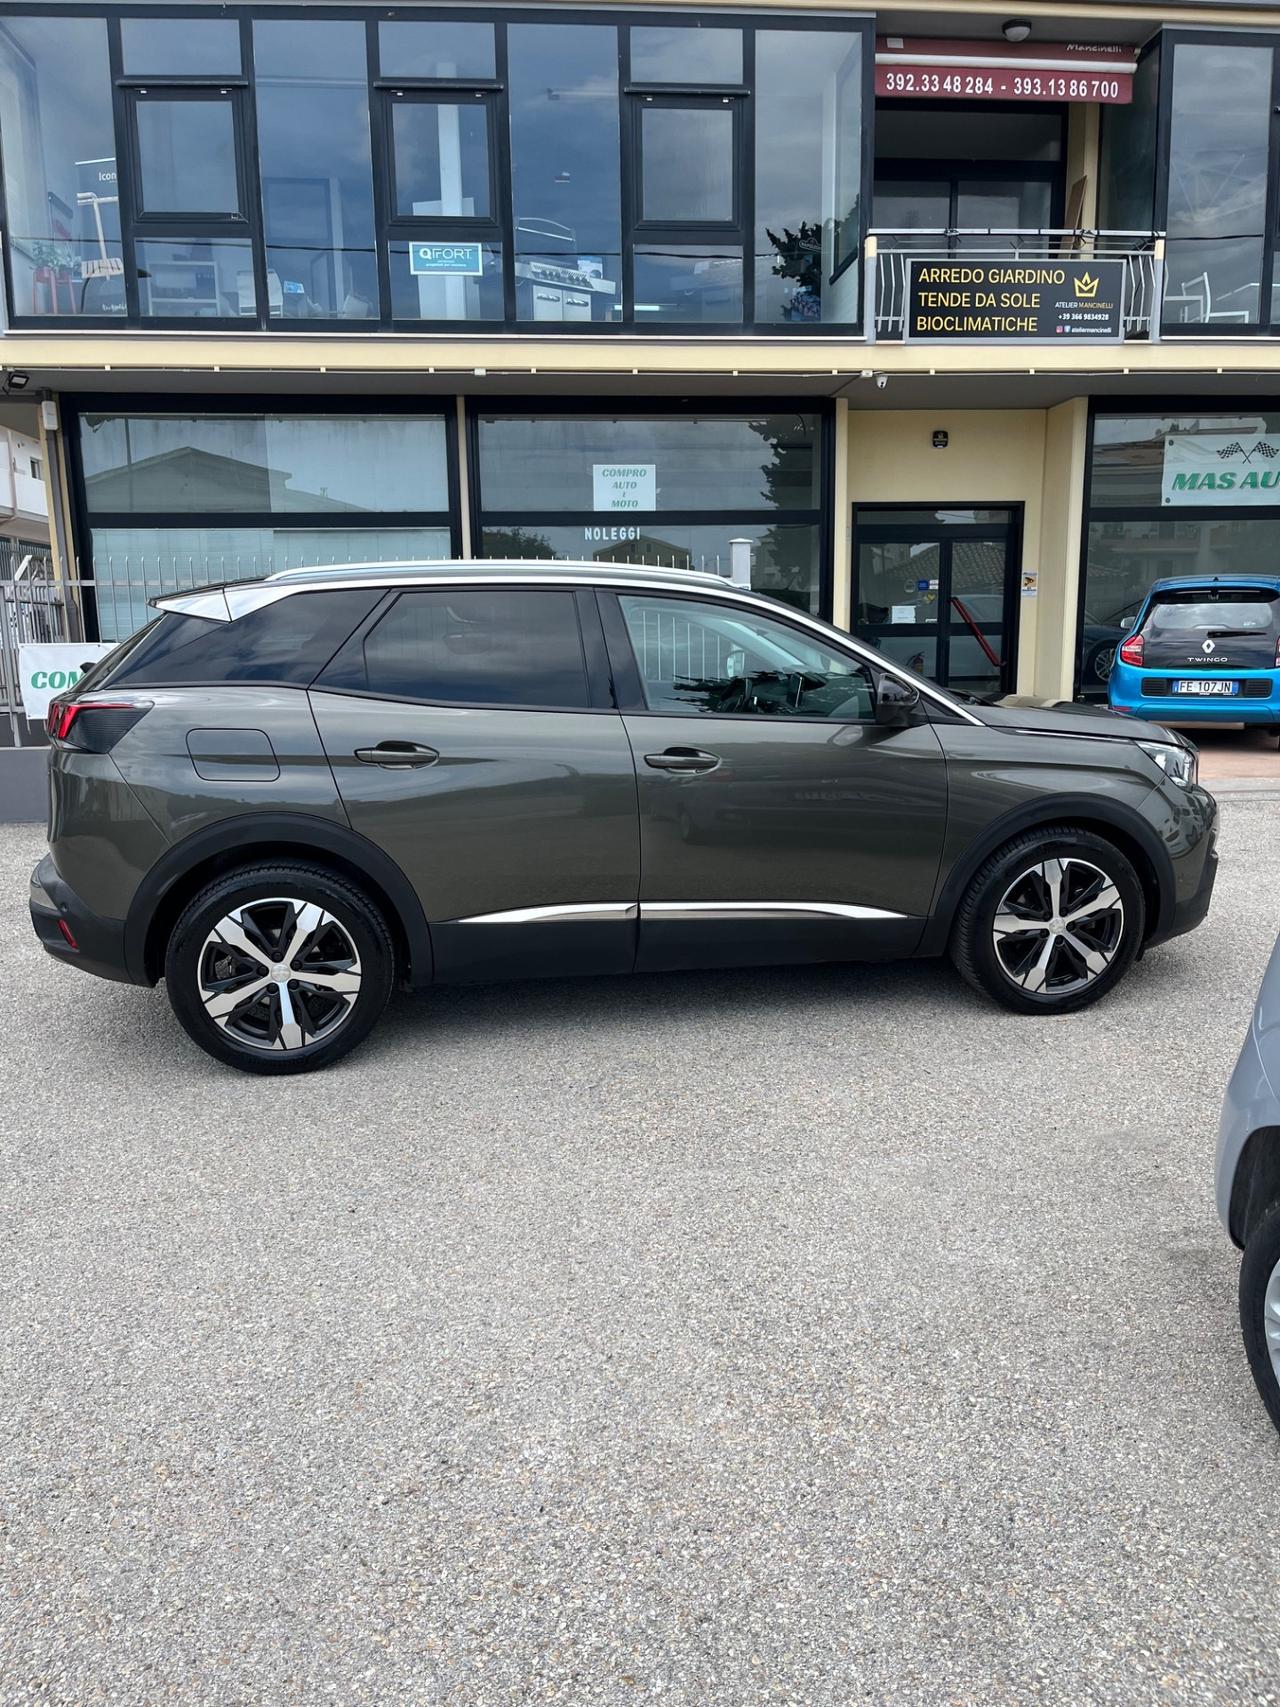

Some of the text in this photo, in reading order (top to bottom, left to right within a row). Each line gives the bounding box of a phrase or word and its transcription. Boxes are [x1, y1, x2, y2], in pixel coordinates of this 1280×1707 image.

[918, 268, 1065, 285] ARREDO GIARDINO
[918, 292, 1041, 308] TENDE DA SOLE
[1078, 301, 1114, 309] MANCINELLI
[916, 316, 1038, 332] BIOCLIMATICHE
[602, 468, 647, 477] COMPRO
[612, 481, 637, 489] AUTO
[1172, 472, 1237, 491] MAS
[611, 500, 638, 508] MOTO
[584, 527, 640, 541] NOLEGGI
[1180, 681, 1193, 692] FE
